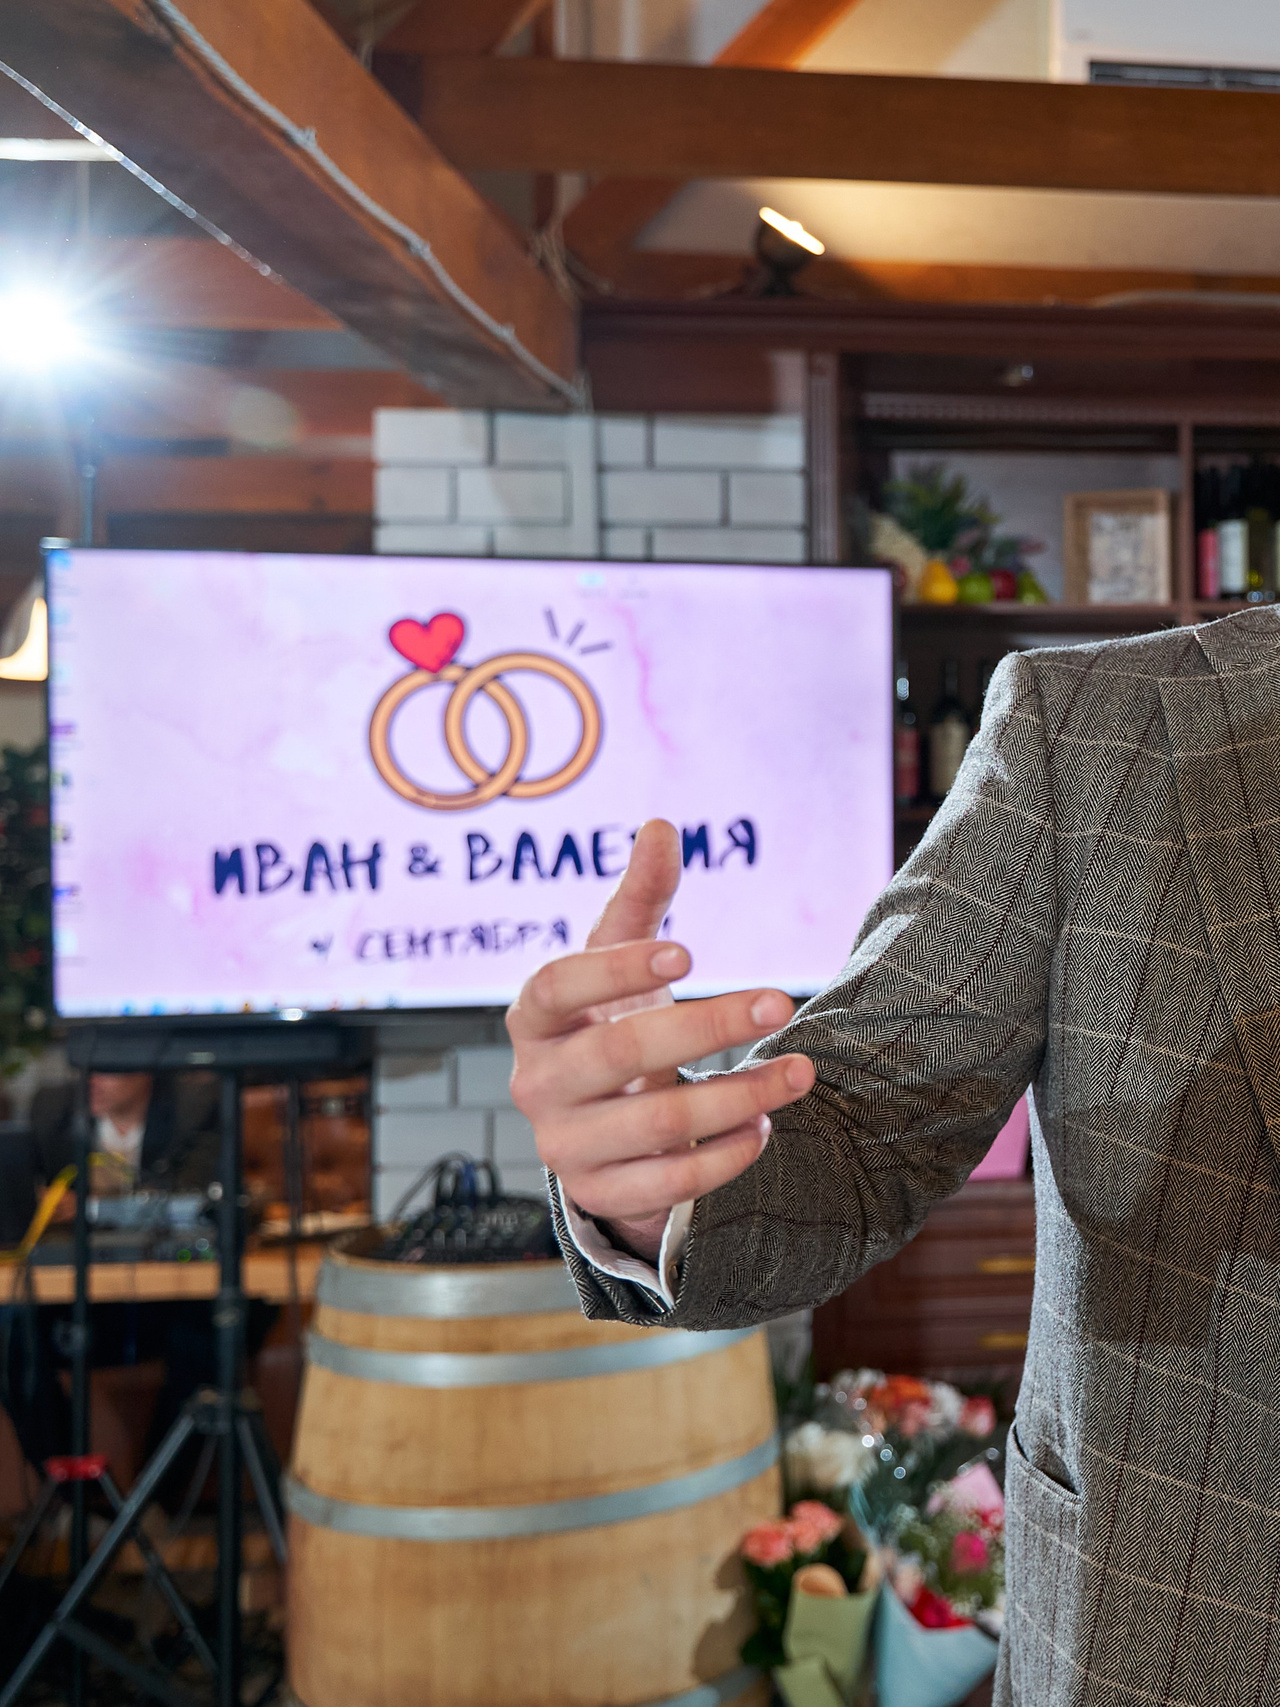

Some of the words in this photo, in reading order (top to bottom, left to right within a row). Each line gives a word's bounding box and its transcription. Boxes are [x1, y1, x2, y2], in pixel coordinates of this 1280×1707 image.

[214, 842, 382, 894] ИВАН
[408, 847, 439, 874] &
[467, 819, 756, 881] ВАЛЕИЯ
[355, 919, 569, 961] СЕНТЯБРЯ
